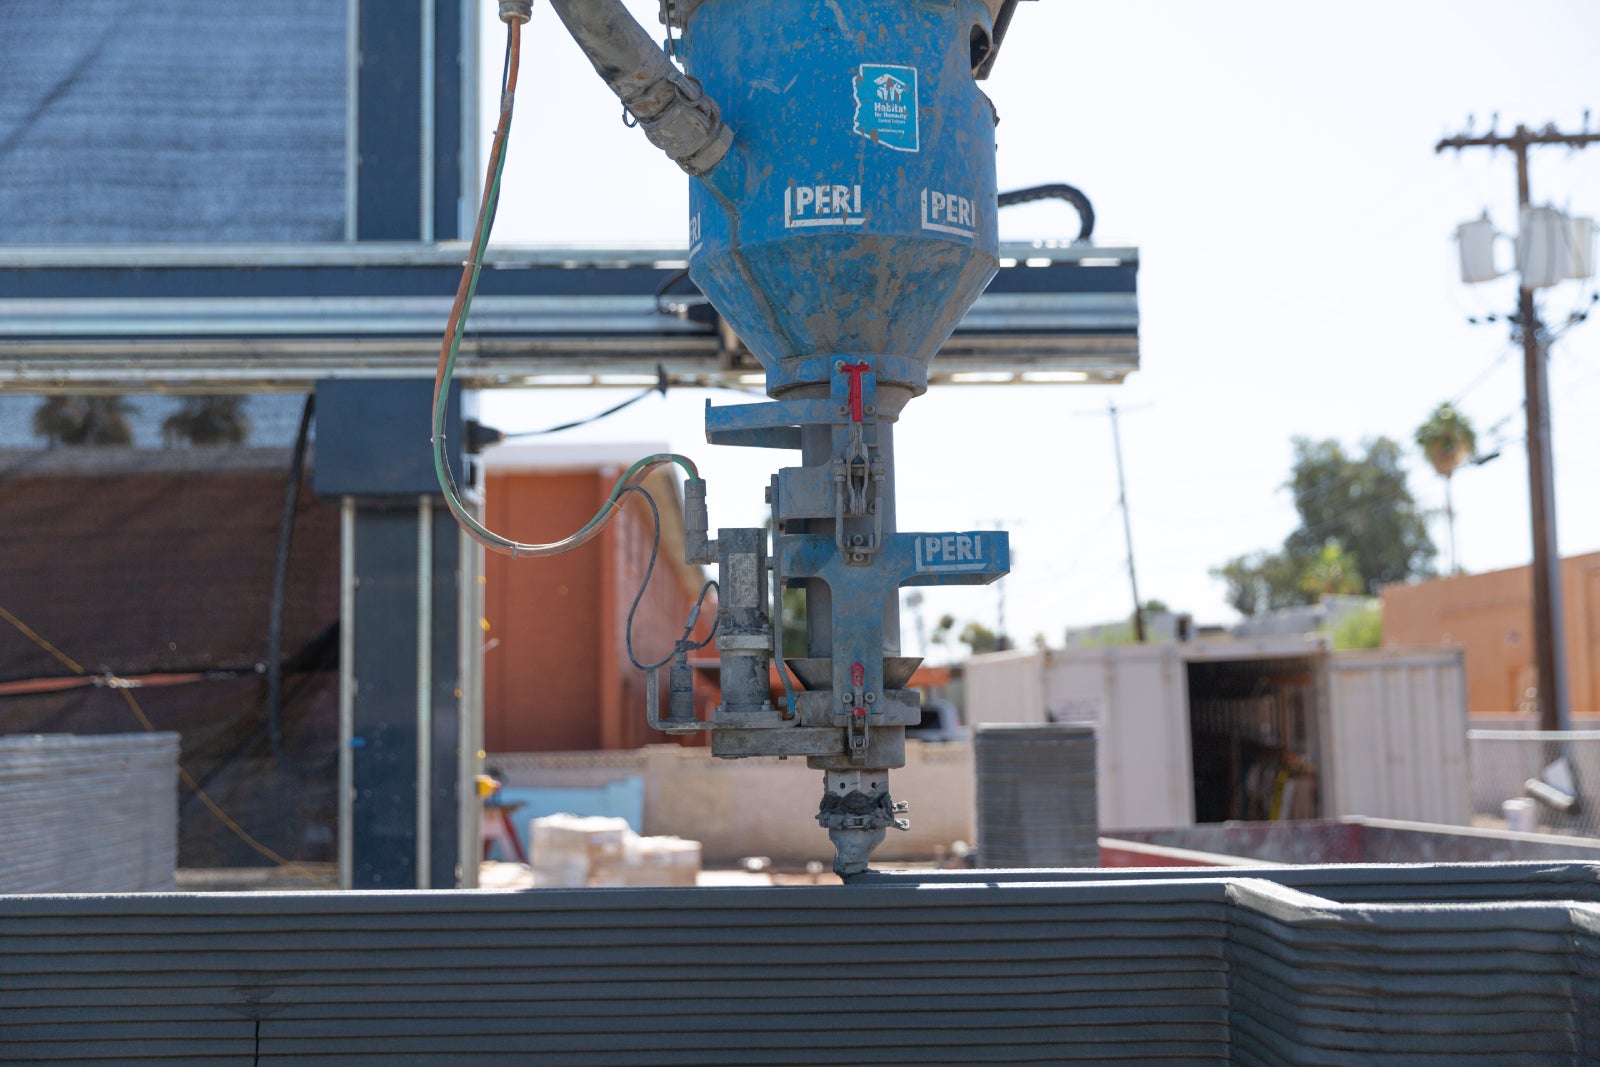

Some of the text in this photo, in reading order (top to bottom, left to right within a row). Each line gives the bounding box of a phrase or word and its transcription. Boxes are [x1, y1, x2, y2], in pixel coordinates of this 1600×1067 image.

[874, 102, 907, 113] Habitat
[796, 185, 862, 215] PERI
[930, 191, 975, 226] PERI
[690, 211, 702, 247] ERI
[925, 535, 982, 562] PERI
